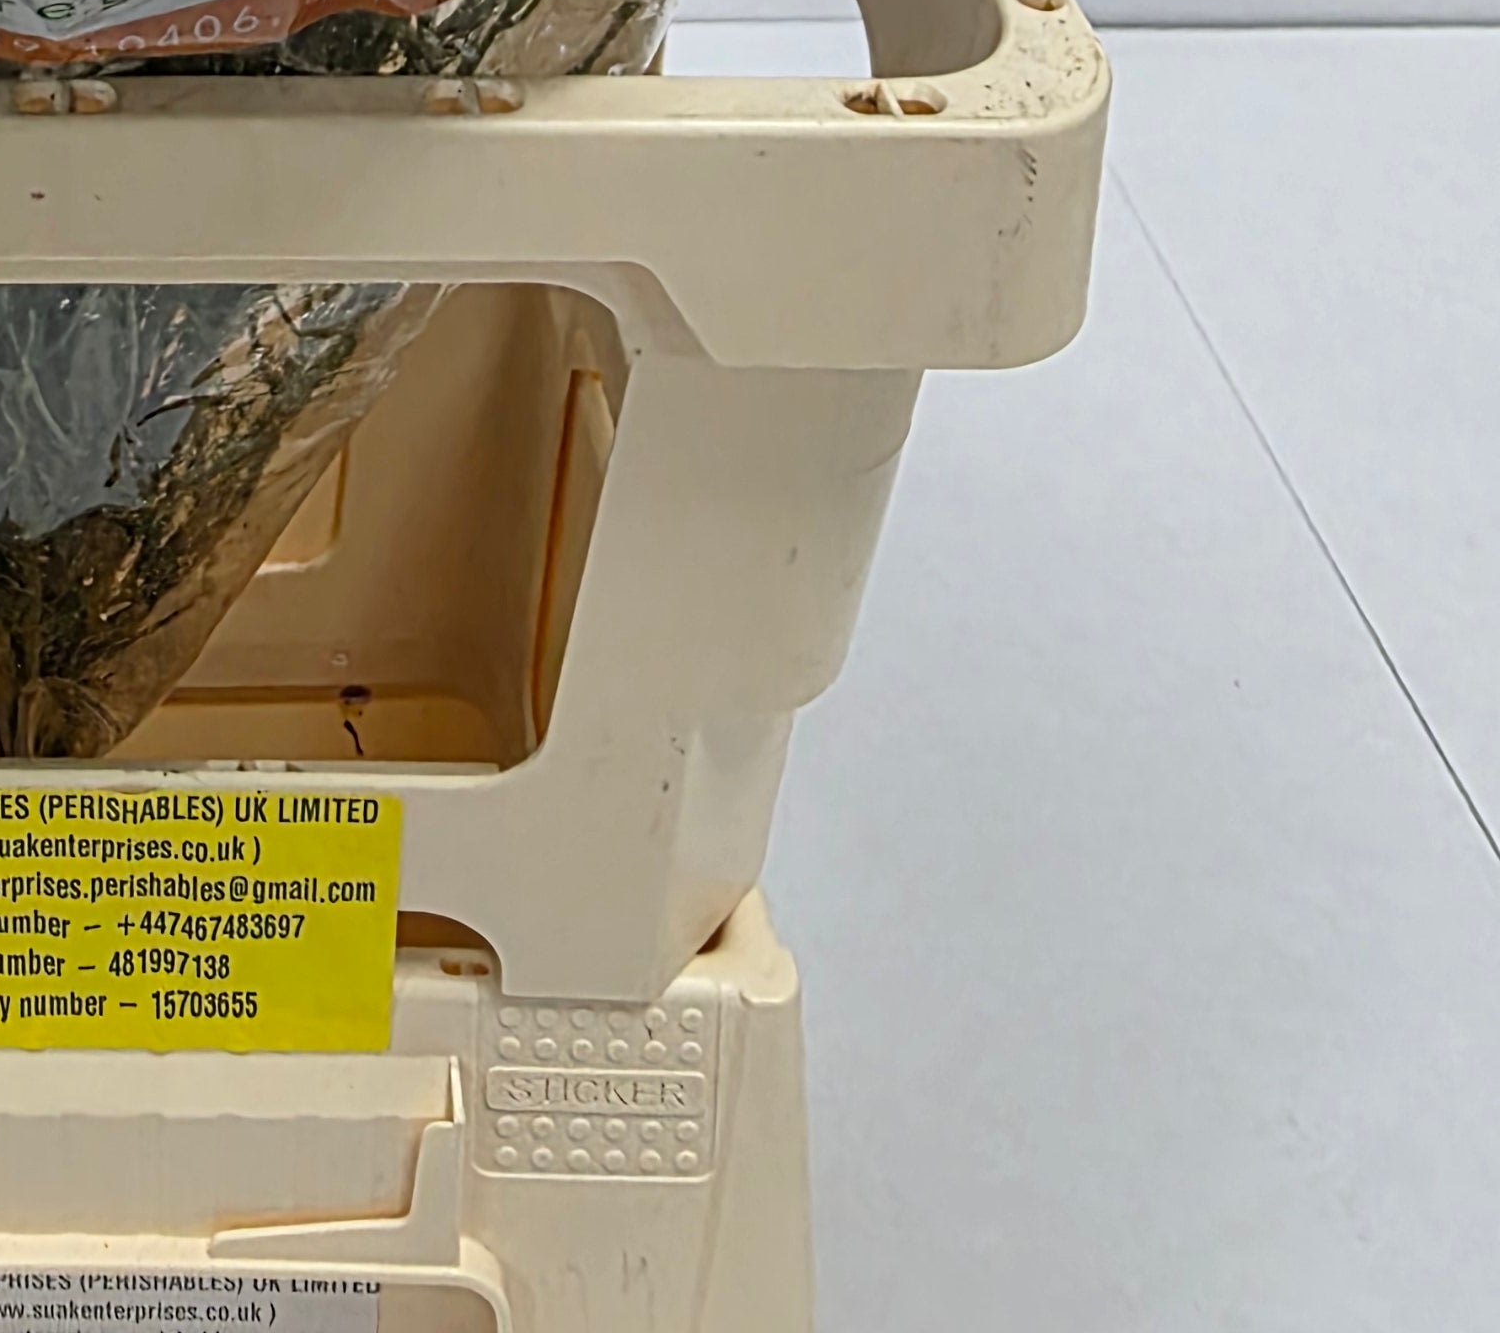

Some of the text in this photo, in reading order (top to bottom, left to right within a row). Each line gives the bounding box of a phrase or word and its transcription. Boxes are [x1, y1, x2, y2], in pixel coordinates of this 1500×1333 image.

[39, 795, 223, 827] (PERISHABLES)
[235, 796, 267, 822] UK
[279, 797, 379, 823] LIMITED
[117, 911, 305, 941] +447467483697
[109, 948, 229, 979] 481997138
[20, 992, 107, 1018] number
[152, 990, 257, 1019] 15703655
[503, 1075, 686, 1107] STICKER
